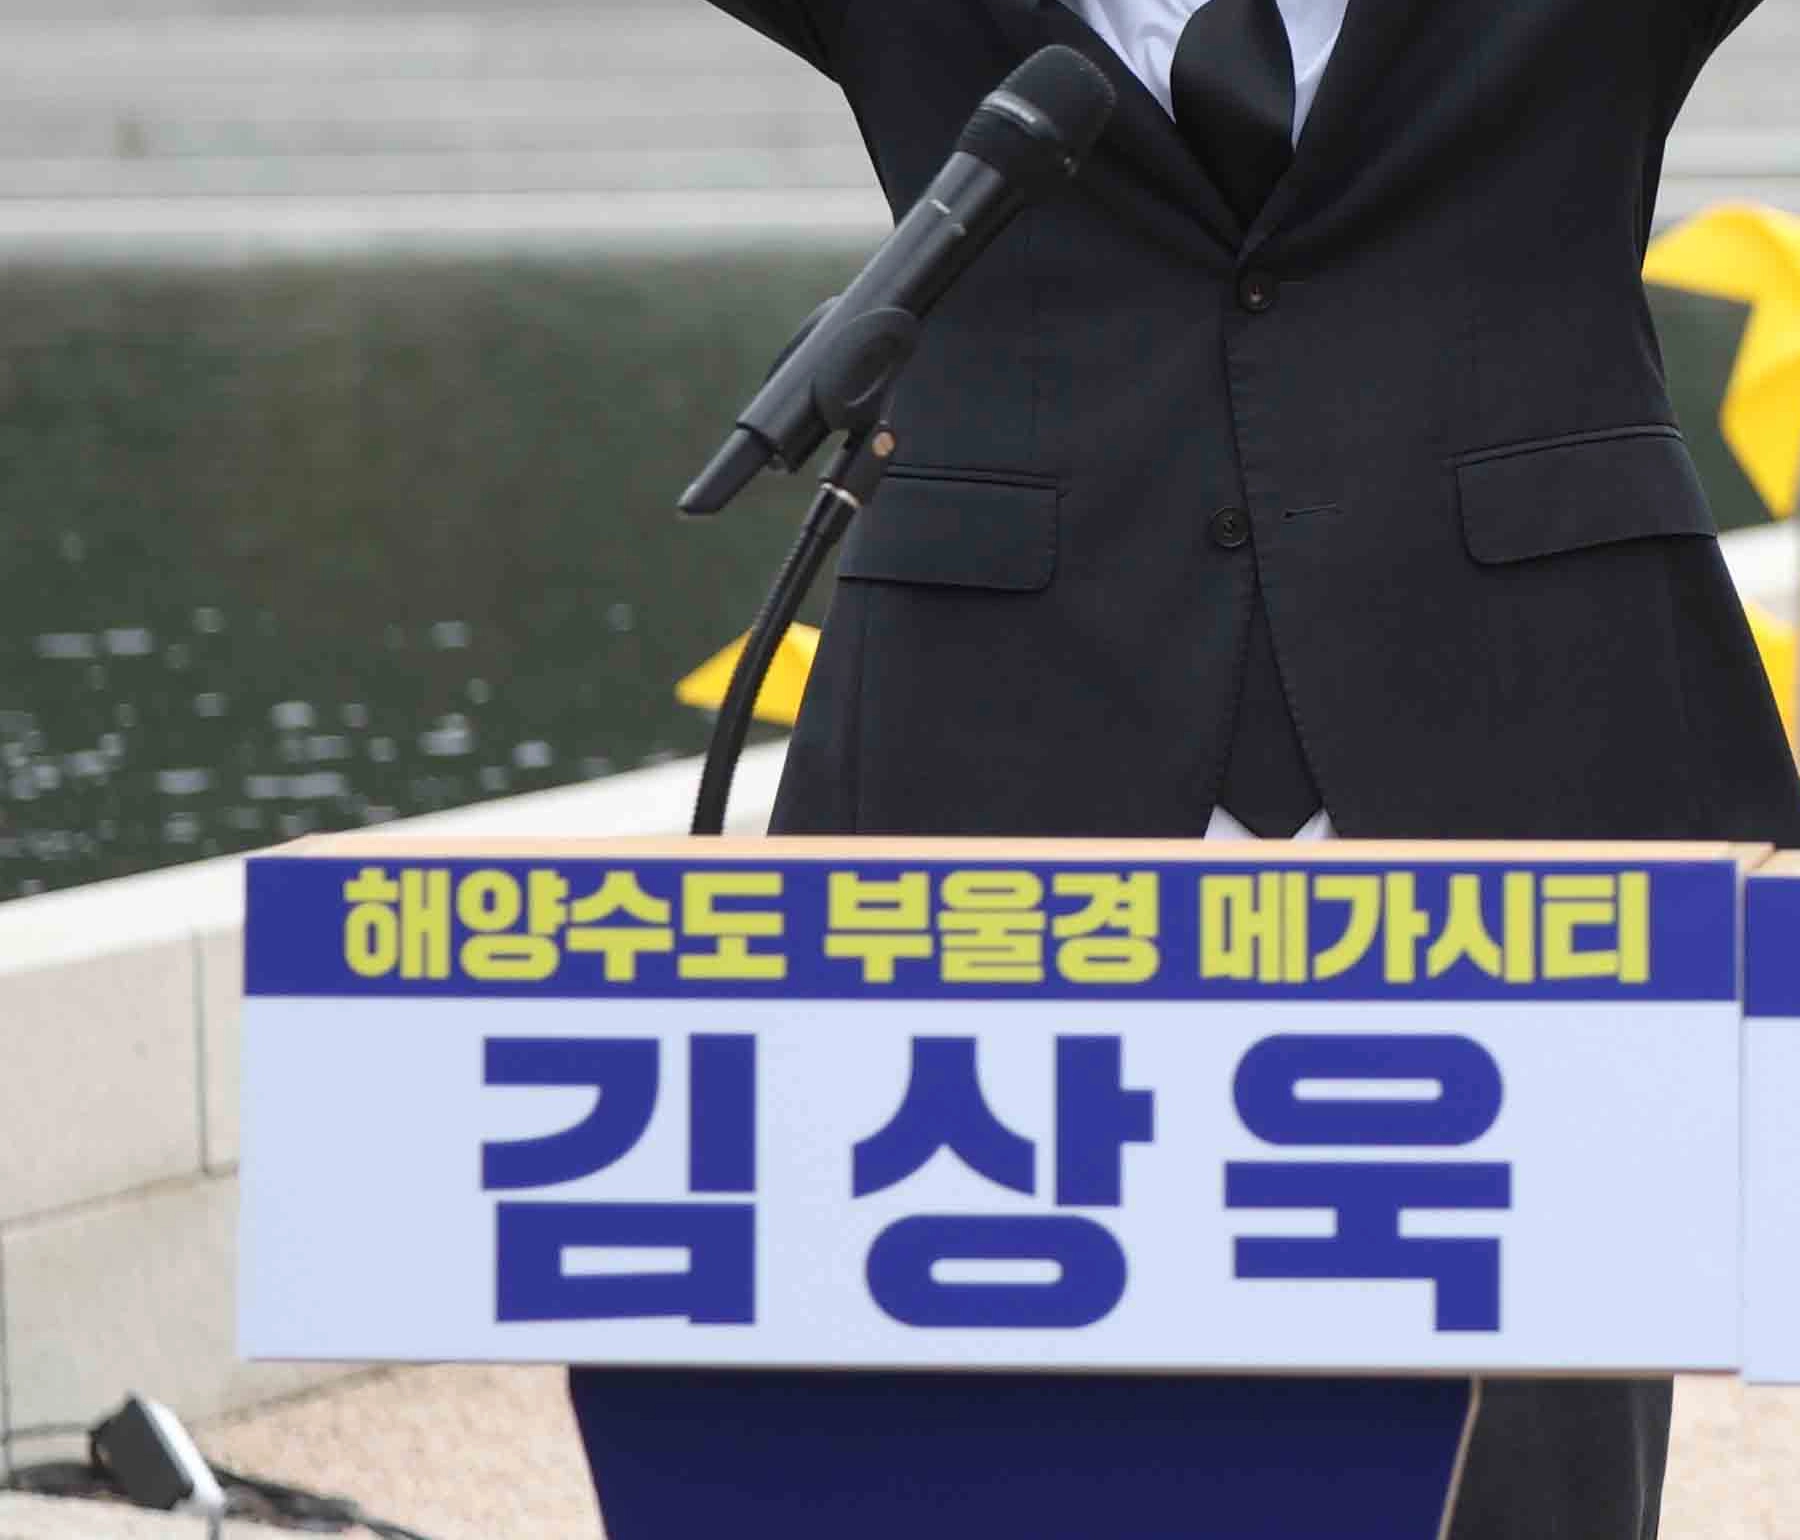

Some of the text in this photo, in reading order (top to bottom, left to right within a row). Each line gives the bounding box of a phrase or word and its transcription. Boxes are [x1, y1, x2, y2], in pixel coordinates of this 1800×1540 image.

[346, 869, 1648, 982] 해양수도 부울경 메가시티
[483, 1034, 1510, 1331] 김상욱
